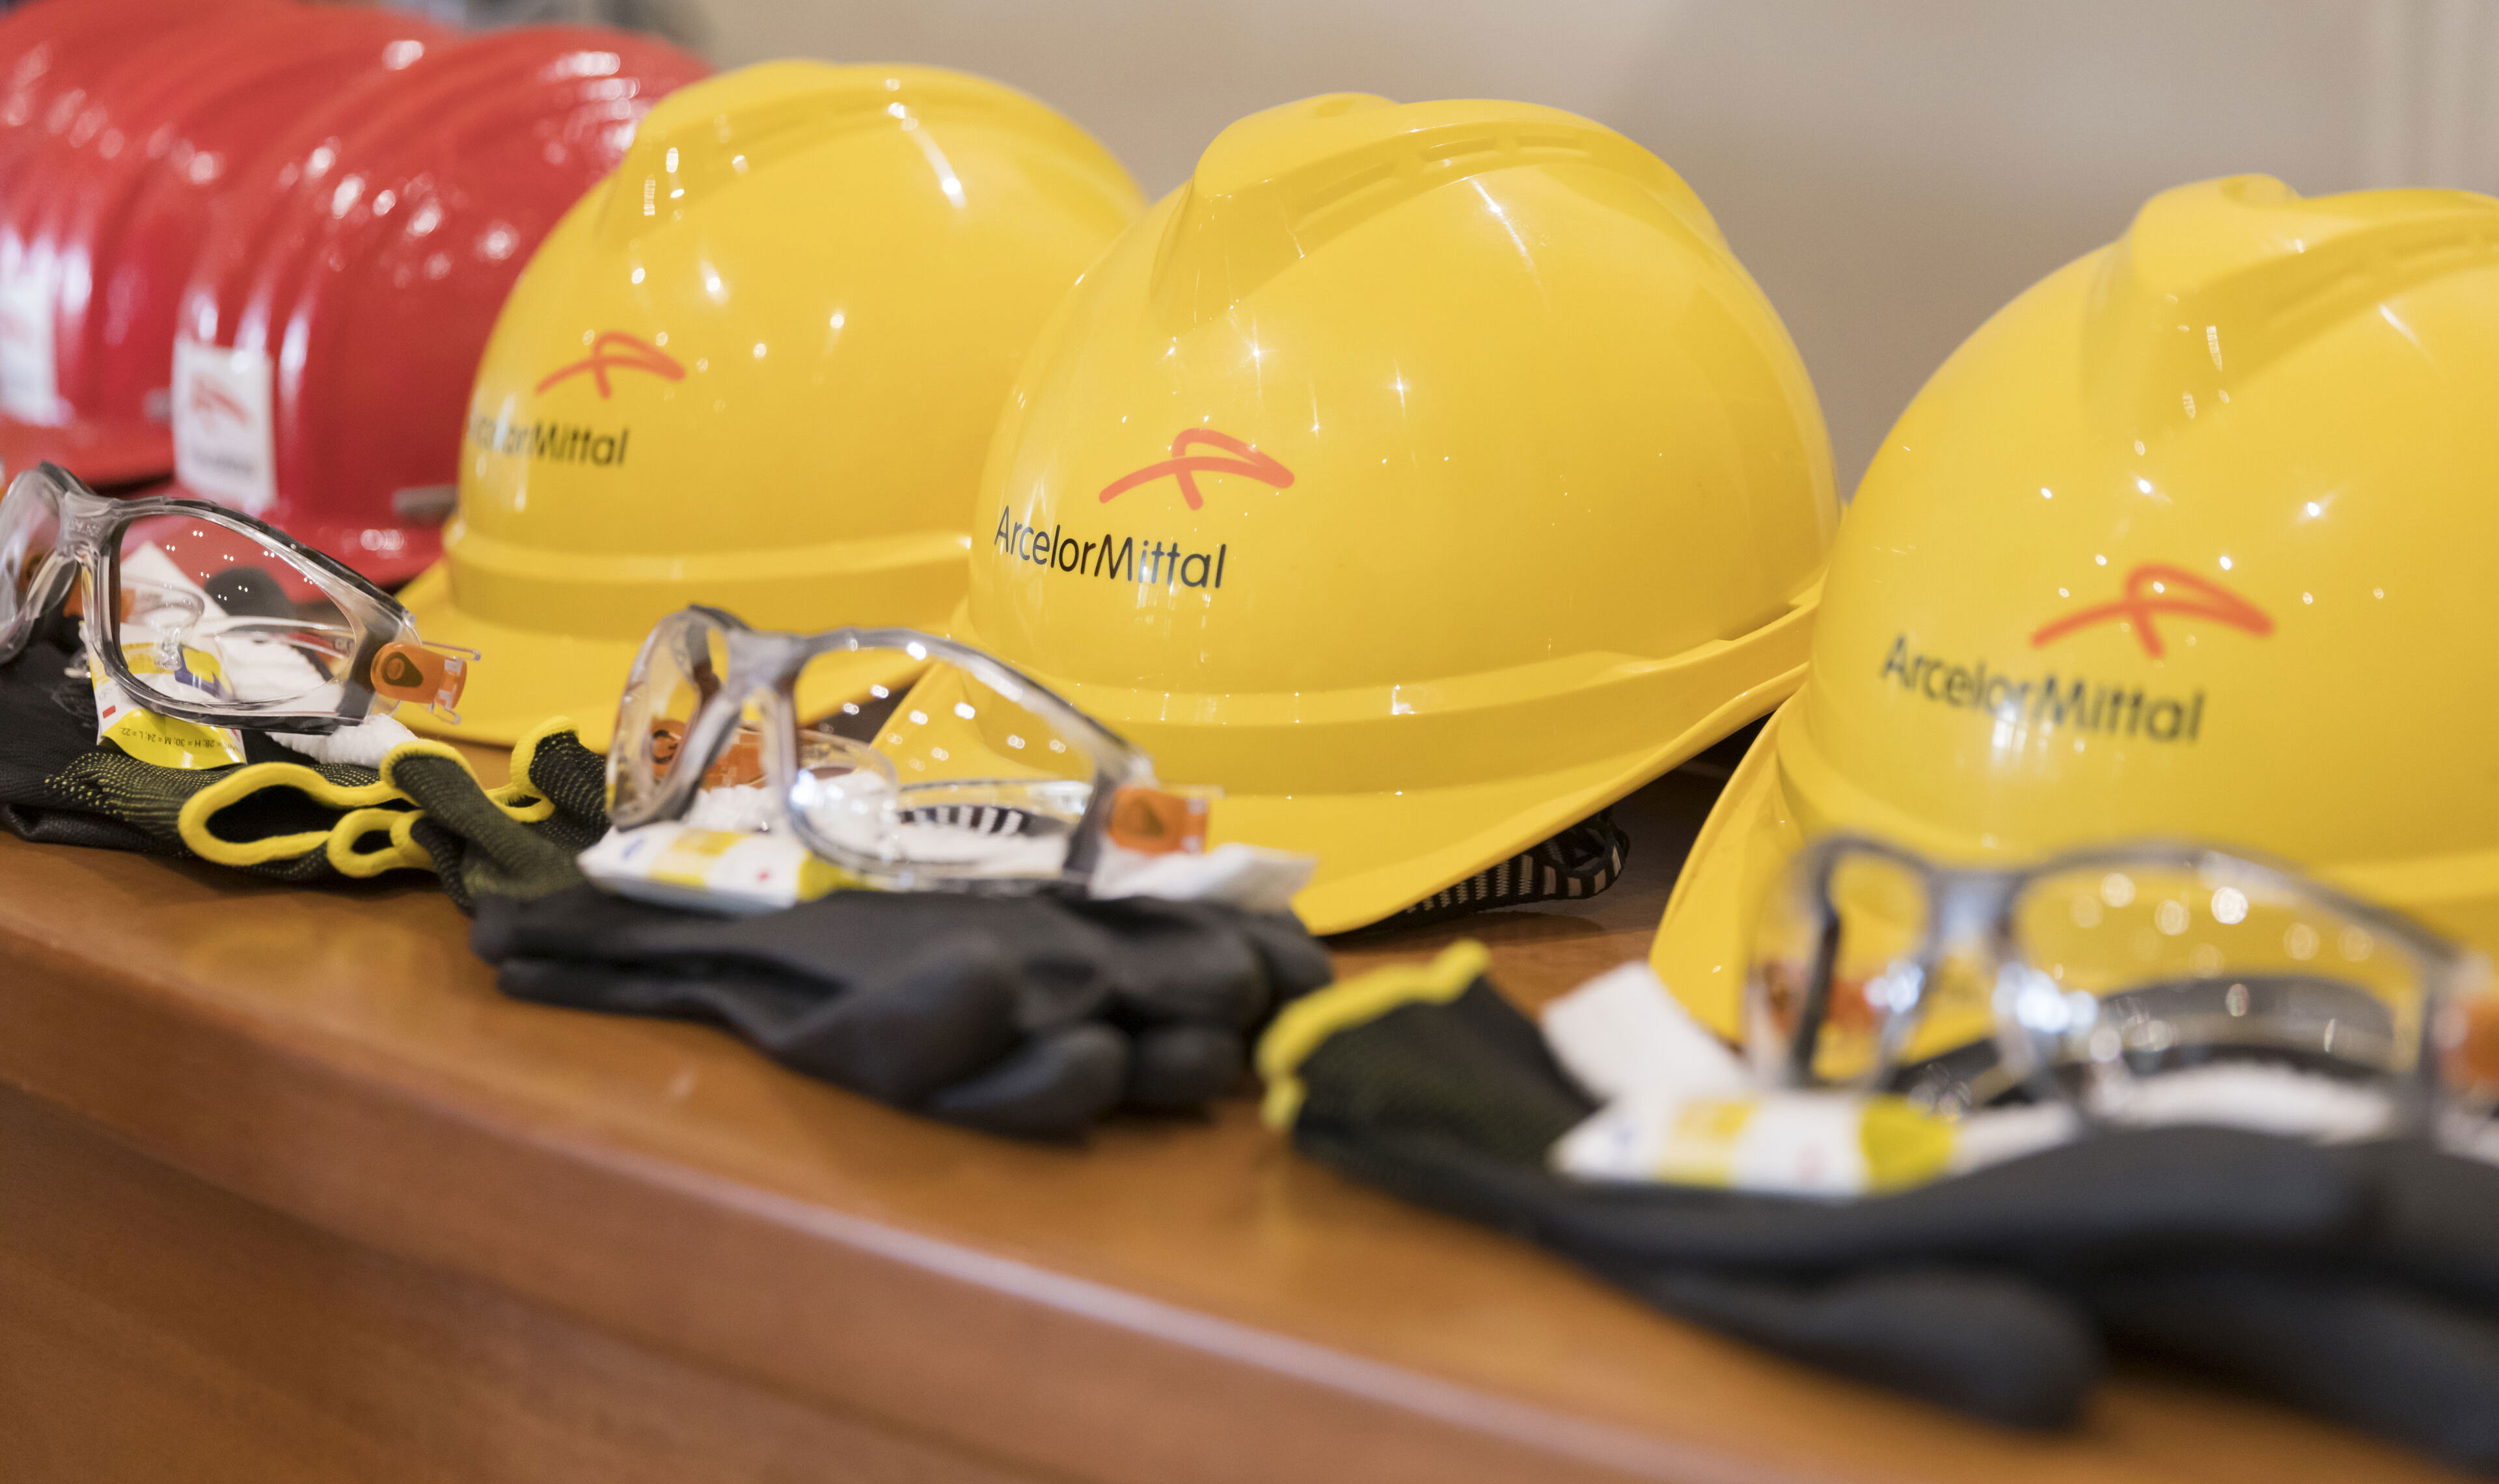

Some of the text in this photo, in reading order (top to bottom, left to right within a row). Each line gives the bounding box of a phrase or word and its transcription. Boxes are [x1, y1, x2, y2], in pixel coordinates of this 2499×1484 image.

[993, 505, 1227, 589] ArcelorMittal
[1880, 633, 2205, 744] ArcelorMittal
[138, 730, 144, 740] L
[164, 736, 172, 745] M
[194, 739, 202, 748] H
